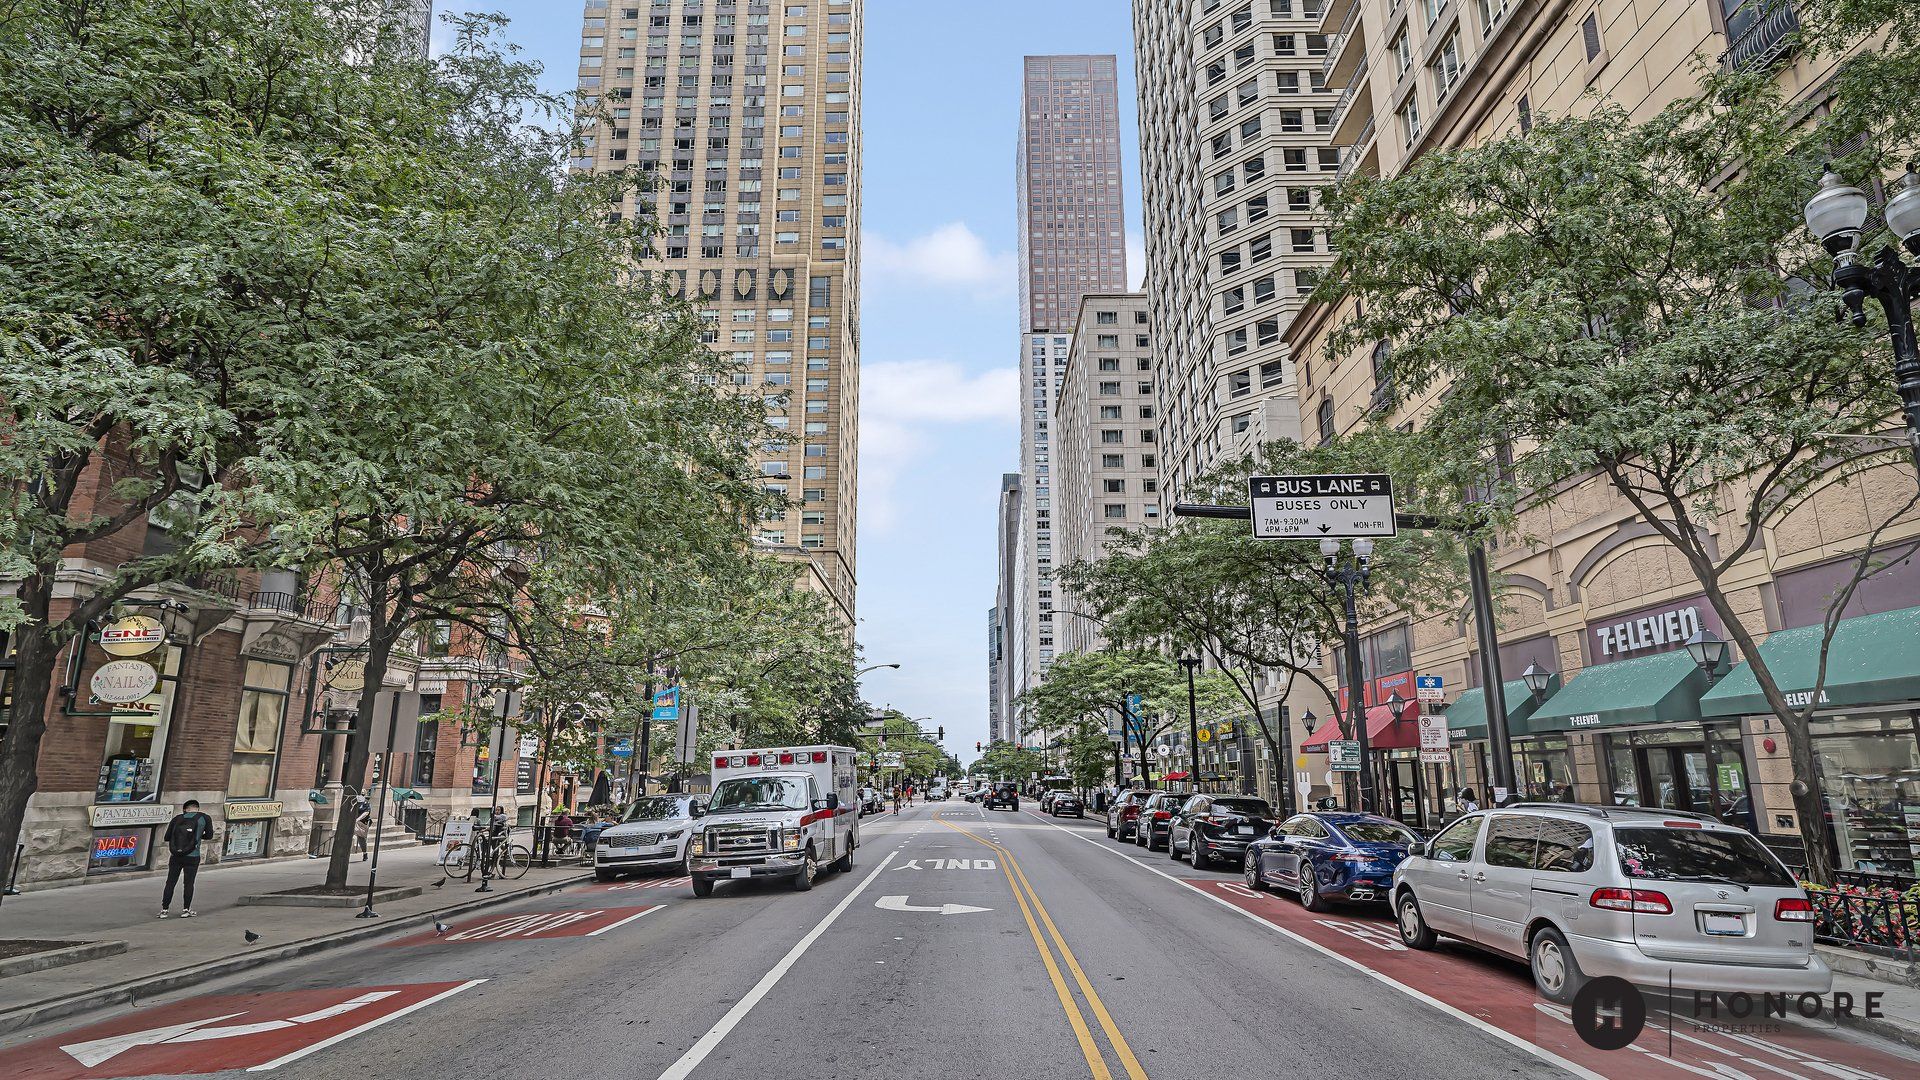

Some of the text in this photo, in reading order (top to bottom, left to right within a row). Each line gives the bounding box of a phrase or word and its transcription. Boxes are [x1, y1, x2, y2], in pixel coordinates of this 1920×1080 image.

[1276, 479, 1365, 494] BUS LANE
[1275, 499, 1368, 511] BUSES ONLY
[1264, 525, 1300, 533] 4PM-6PM
[1353, 521, 1385, 529] MON-FRI
[103, 629, 161, 638] GNC
[107, 662, 145, 672] FANTASY
[103, 675, 144, 689] NAILS
[103, 806, 168, 819] FANTASY NAILS
[98, 836, 137, 850] NAILS
[892, 859, 997, 870] ONLY
